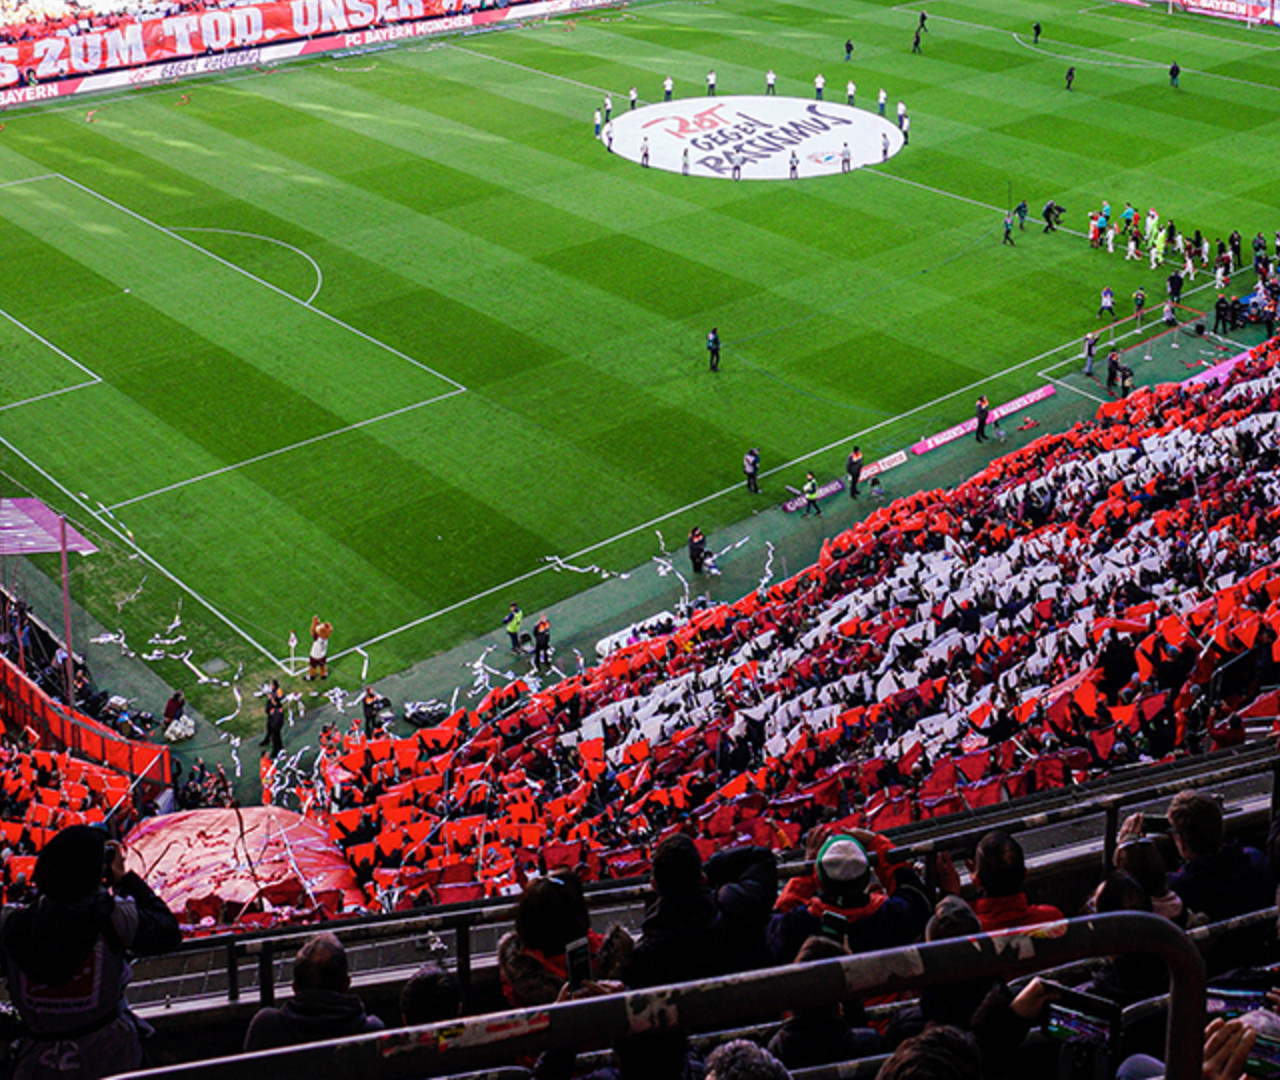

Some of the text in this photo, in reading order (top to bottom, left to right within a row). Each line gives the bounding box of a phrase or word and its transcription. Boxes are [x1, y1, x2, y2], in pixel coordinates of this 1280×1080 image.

[33, 23, 147, 77] ZUM
[162, 6, 276, 55] TOD.
[345, 33, 363, 47] FC
[365, 24, 414, 44] BAYERN
[690, 111, 775, 153] GEGEN
